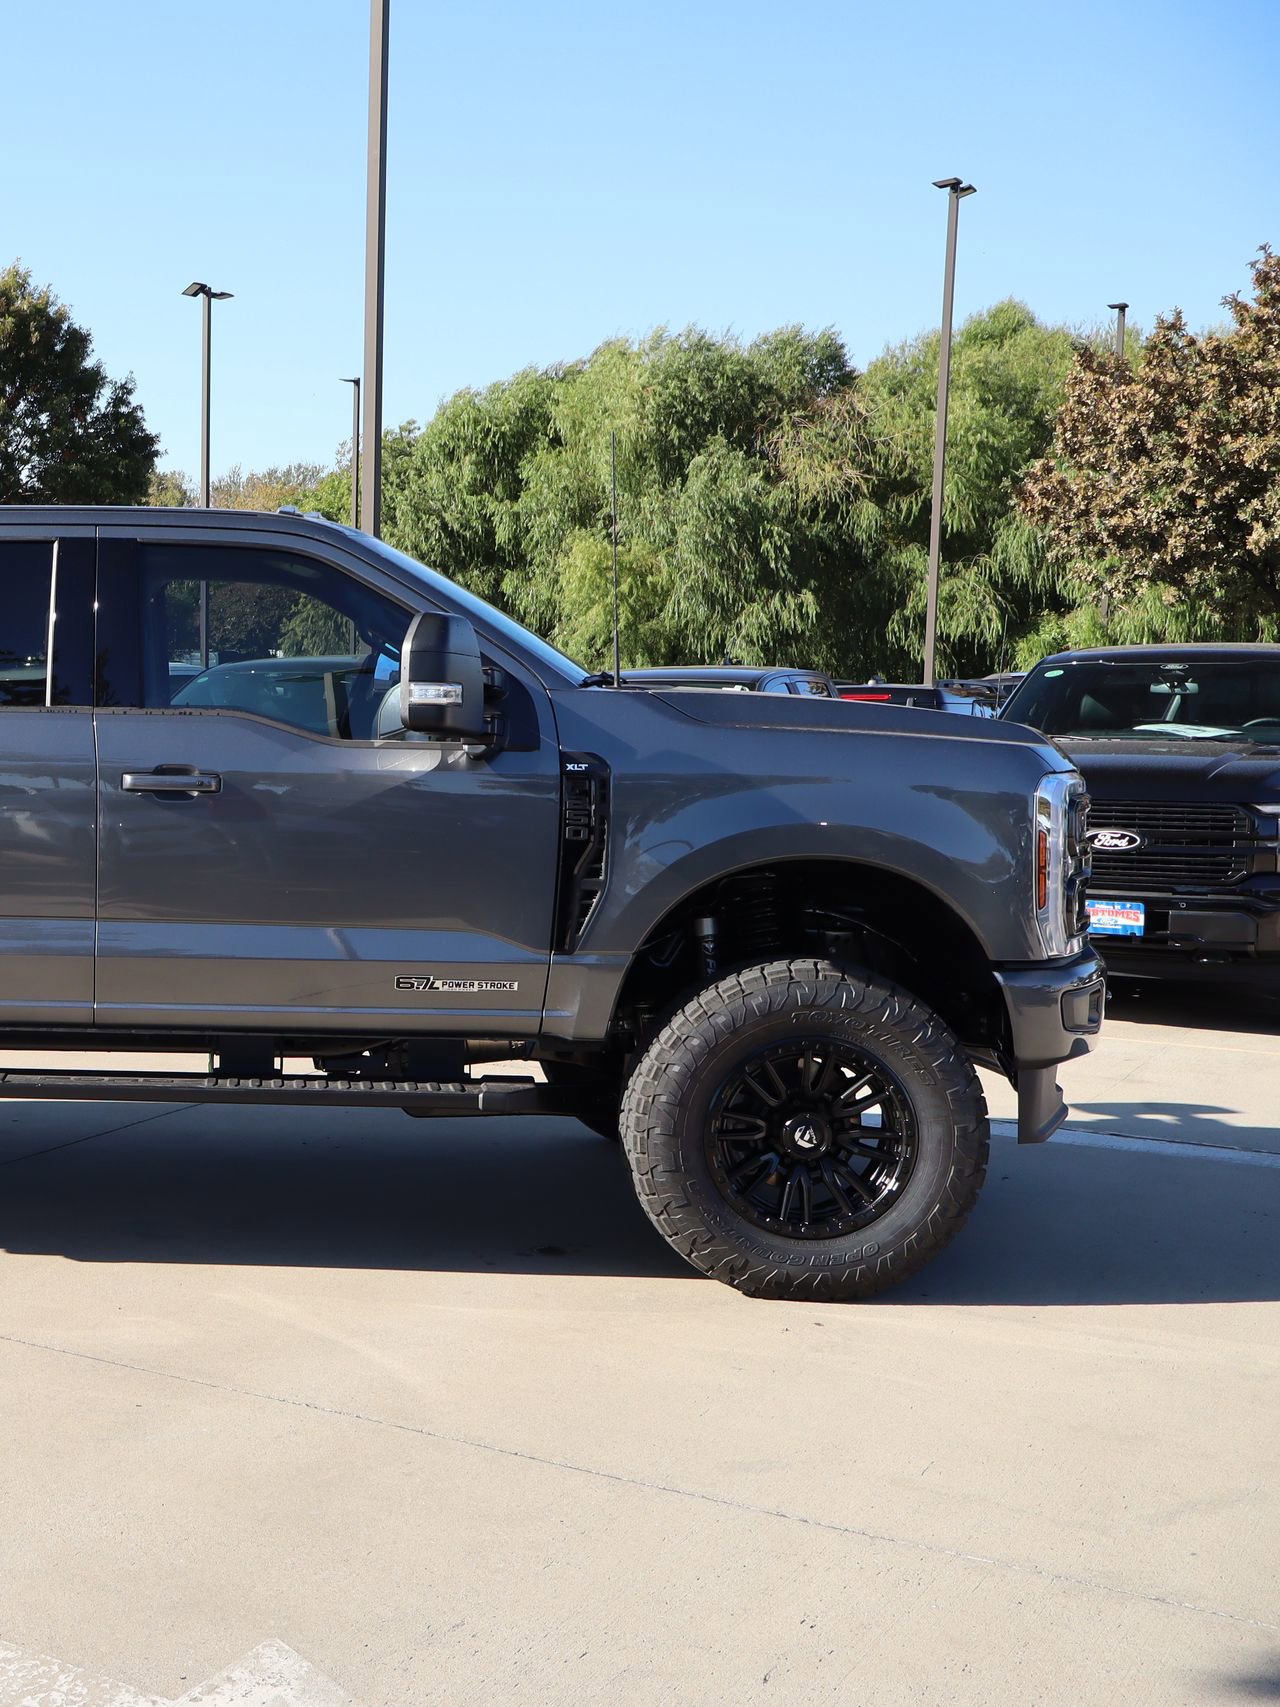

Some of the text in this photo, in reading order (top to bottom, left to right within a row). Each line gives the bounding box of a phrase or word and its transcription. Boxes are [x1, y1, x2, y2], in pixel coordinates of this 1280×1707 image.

[565, 763, 589, 771] XLT
[1094, 832, 1130, 846] Ford
[442, 981, 475, 989] POWER
[791, 1010, 866, 1030] TOYO
[809, 1241, 880, 1266] OPEN
